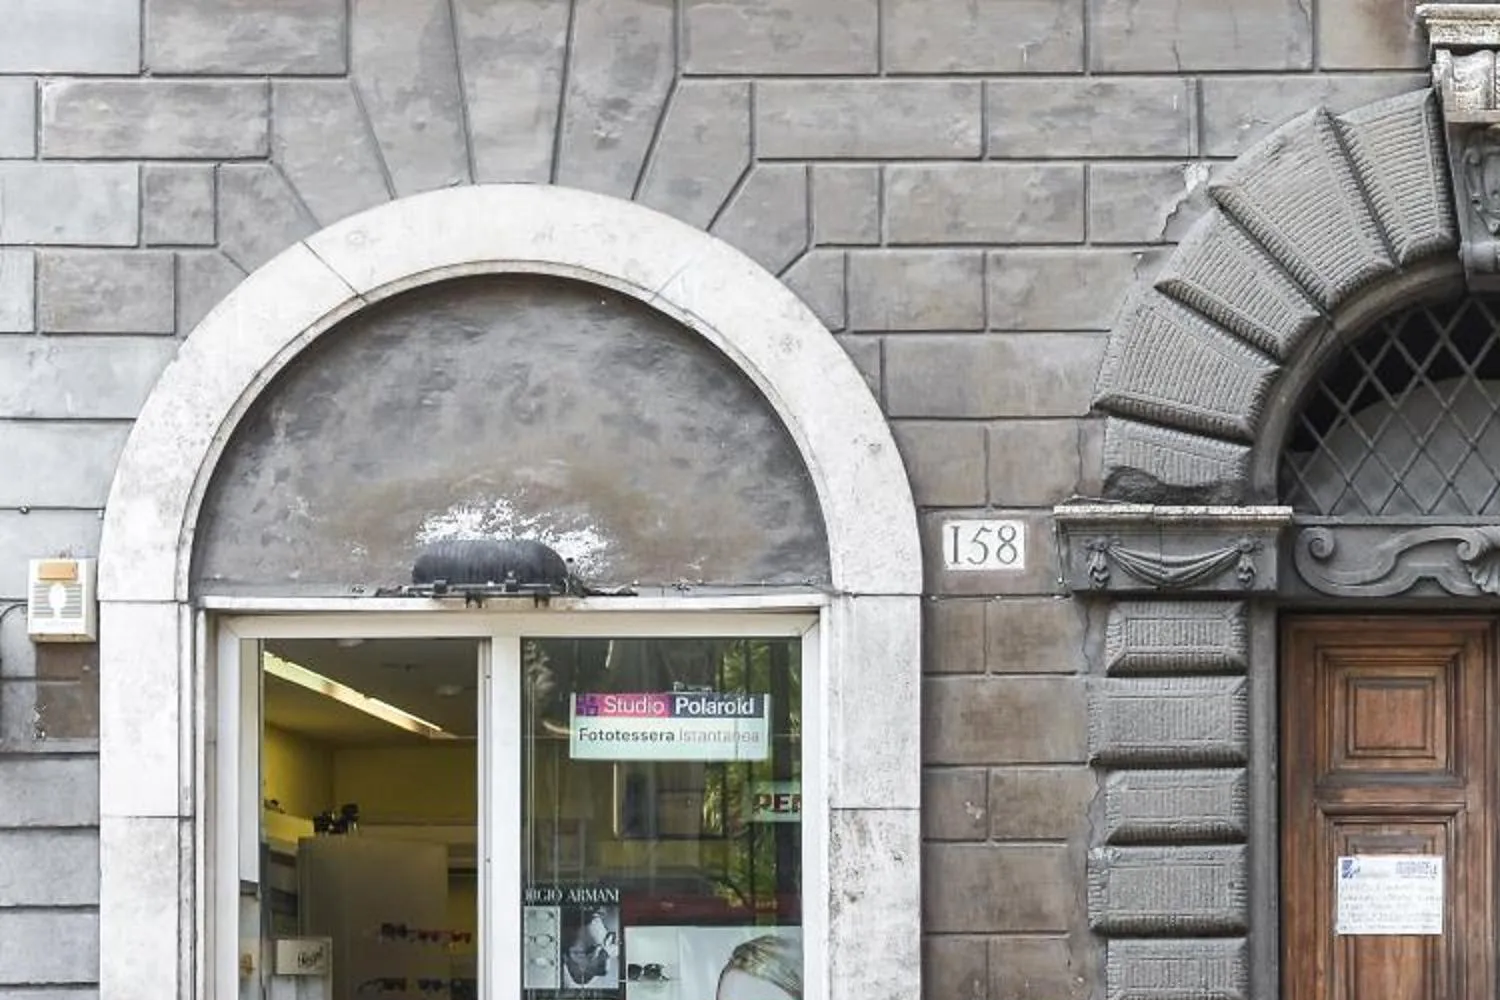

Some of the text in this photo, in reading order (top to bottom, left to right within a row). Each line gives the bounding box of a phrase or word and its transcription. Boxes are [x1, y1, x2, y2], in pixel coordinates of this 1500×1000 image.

[947, 524, 1018, 566] 158
[603, 696, 754, 715] Studio Polaroid
[579, 727, 675, 743] Fototessera
[567, 887, 620, 903] ARMANI
